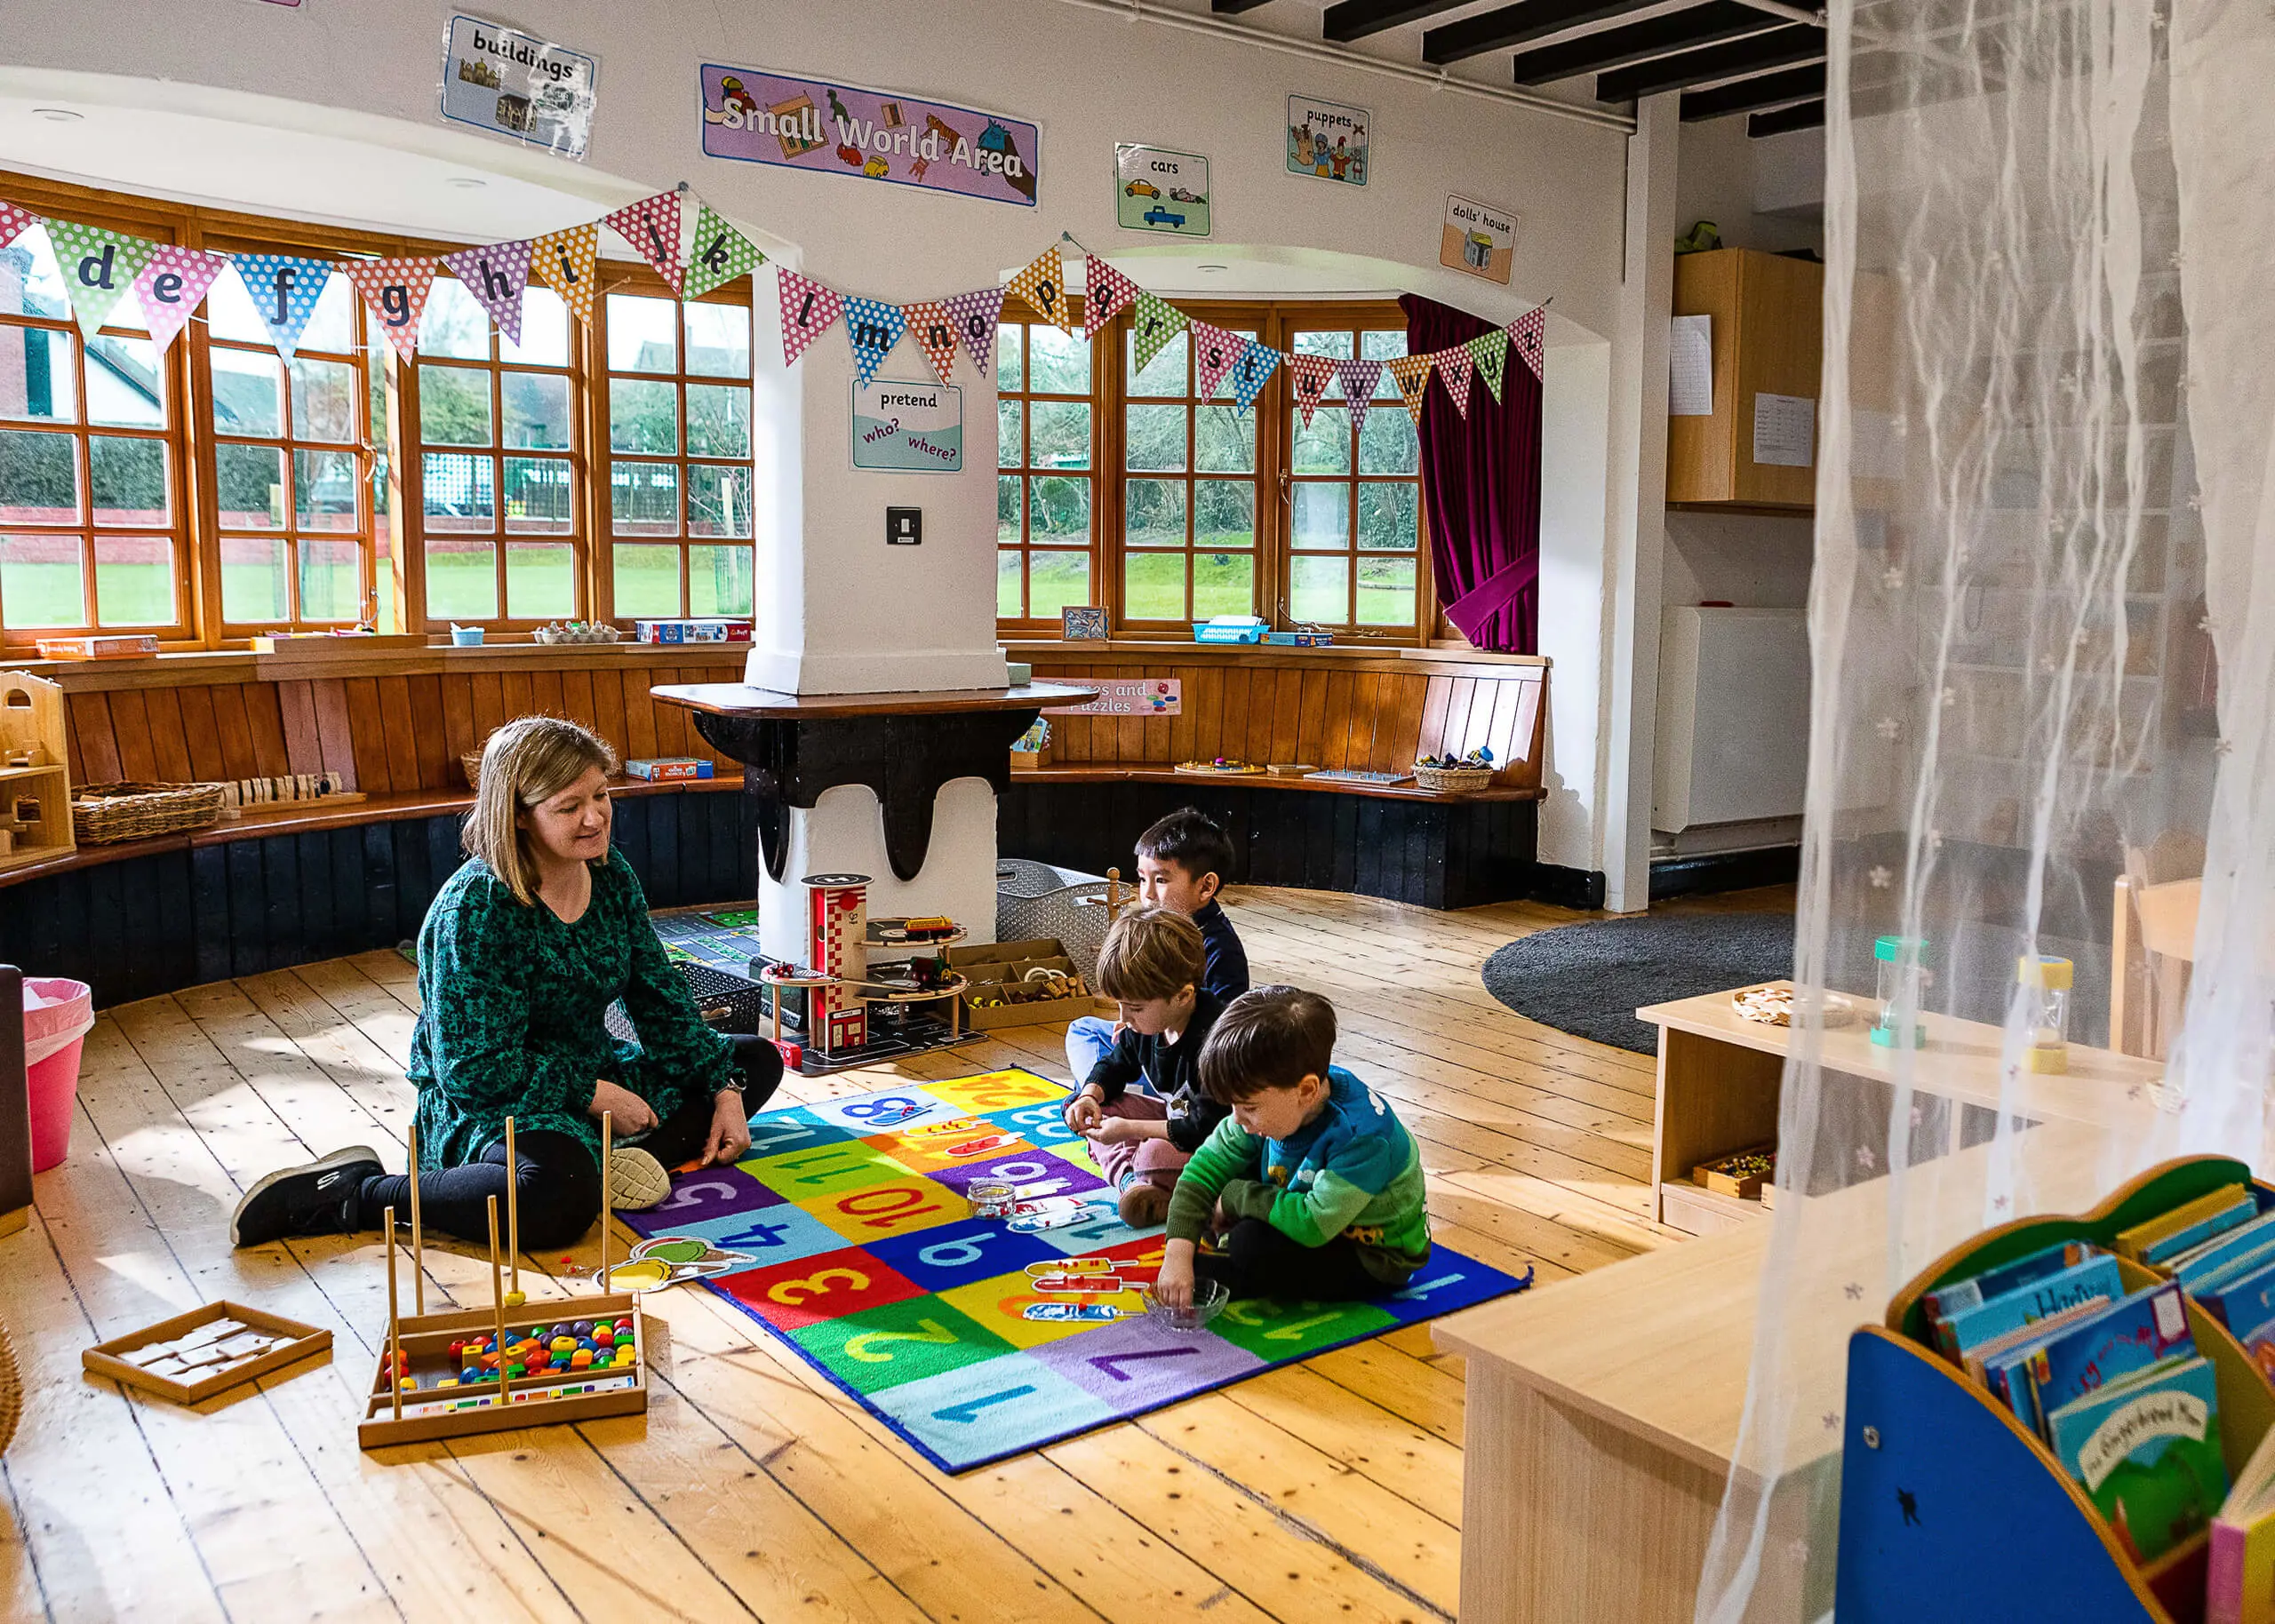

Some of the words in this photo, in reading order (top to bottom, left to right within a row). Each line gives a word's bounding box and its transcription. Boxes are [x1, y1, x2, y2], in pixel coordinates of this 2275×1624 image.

[473, 28, 574, 82] buildings
[1306, 109, 1352, 129] puppets
[722, 97, 824, 143] Small
[835, 114, 940, 163] World
[950, 136, 1024, 179] Area
[1150, 159, 1179, 174] cars
[1452, 203, 1481, 222] dolls'
[1482, 213, 1511, 234] house
[78, 244, 116, 291] d
[152, 272, 183, 304] e
[269, 267, 297, 325] f
[381, 284, 411, 327] g
[479, 259, 515, 301] h
[556, 243, 579, 284] i
[643, 212, 667, 264] j
[700, 232, 730, 275] k
[798, 291, 816, 328] l
[855, 320, 890, 352] m
[929, 321, 954, 349] n
[968, 313, 986, 338] o
[1034, 279, 1057, 316] p
[1093, 283, 1114, 318] q
[1143, 314, 1164, 339] r
[1206, 346, 1223, 370] s
[1243, 356, 1256, 383] t
[1303, 372, 1317, 395] u
[1351, 378, 1366, 400] v
[1401, 372, 1423, 394] w
[1451, 365, 1465, 386] x
[1482, 350, 1497, 380] y
[1523, 330, 1537, 353] z
[881, 393, 938, 410] pretend
[862, 418, 900, 444] who?
[908, 436, 957, 462] where?
[1115, 681, 1148, 697] and
[948, 1075, 1051, 1107] 24
[773, 1151, 871, 1184] 11
[659, 1182, 738, 1211] 5
[836, 1187, 945, 1228] 10
[717, 1222, 792, 1248] 4
[767, 1268, 871, 1306] 3
[843, 1318, 960, 1364] 2
[1085, 1347, 1201, 1382] 7
[930, 1383, 1037, 1423] 1
